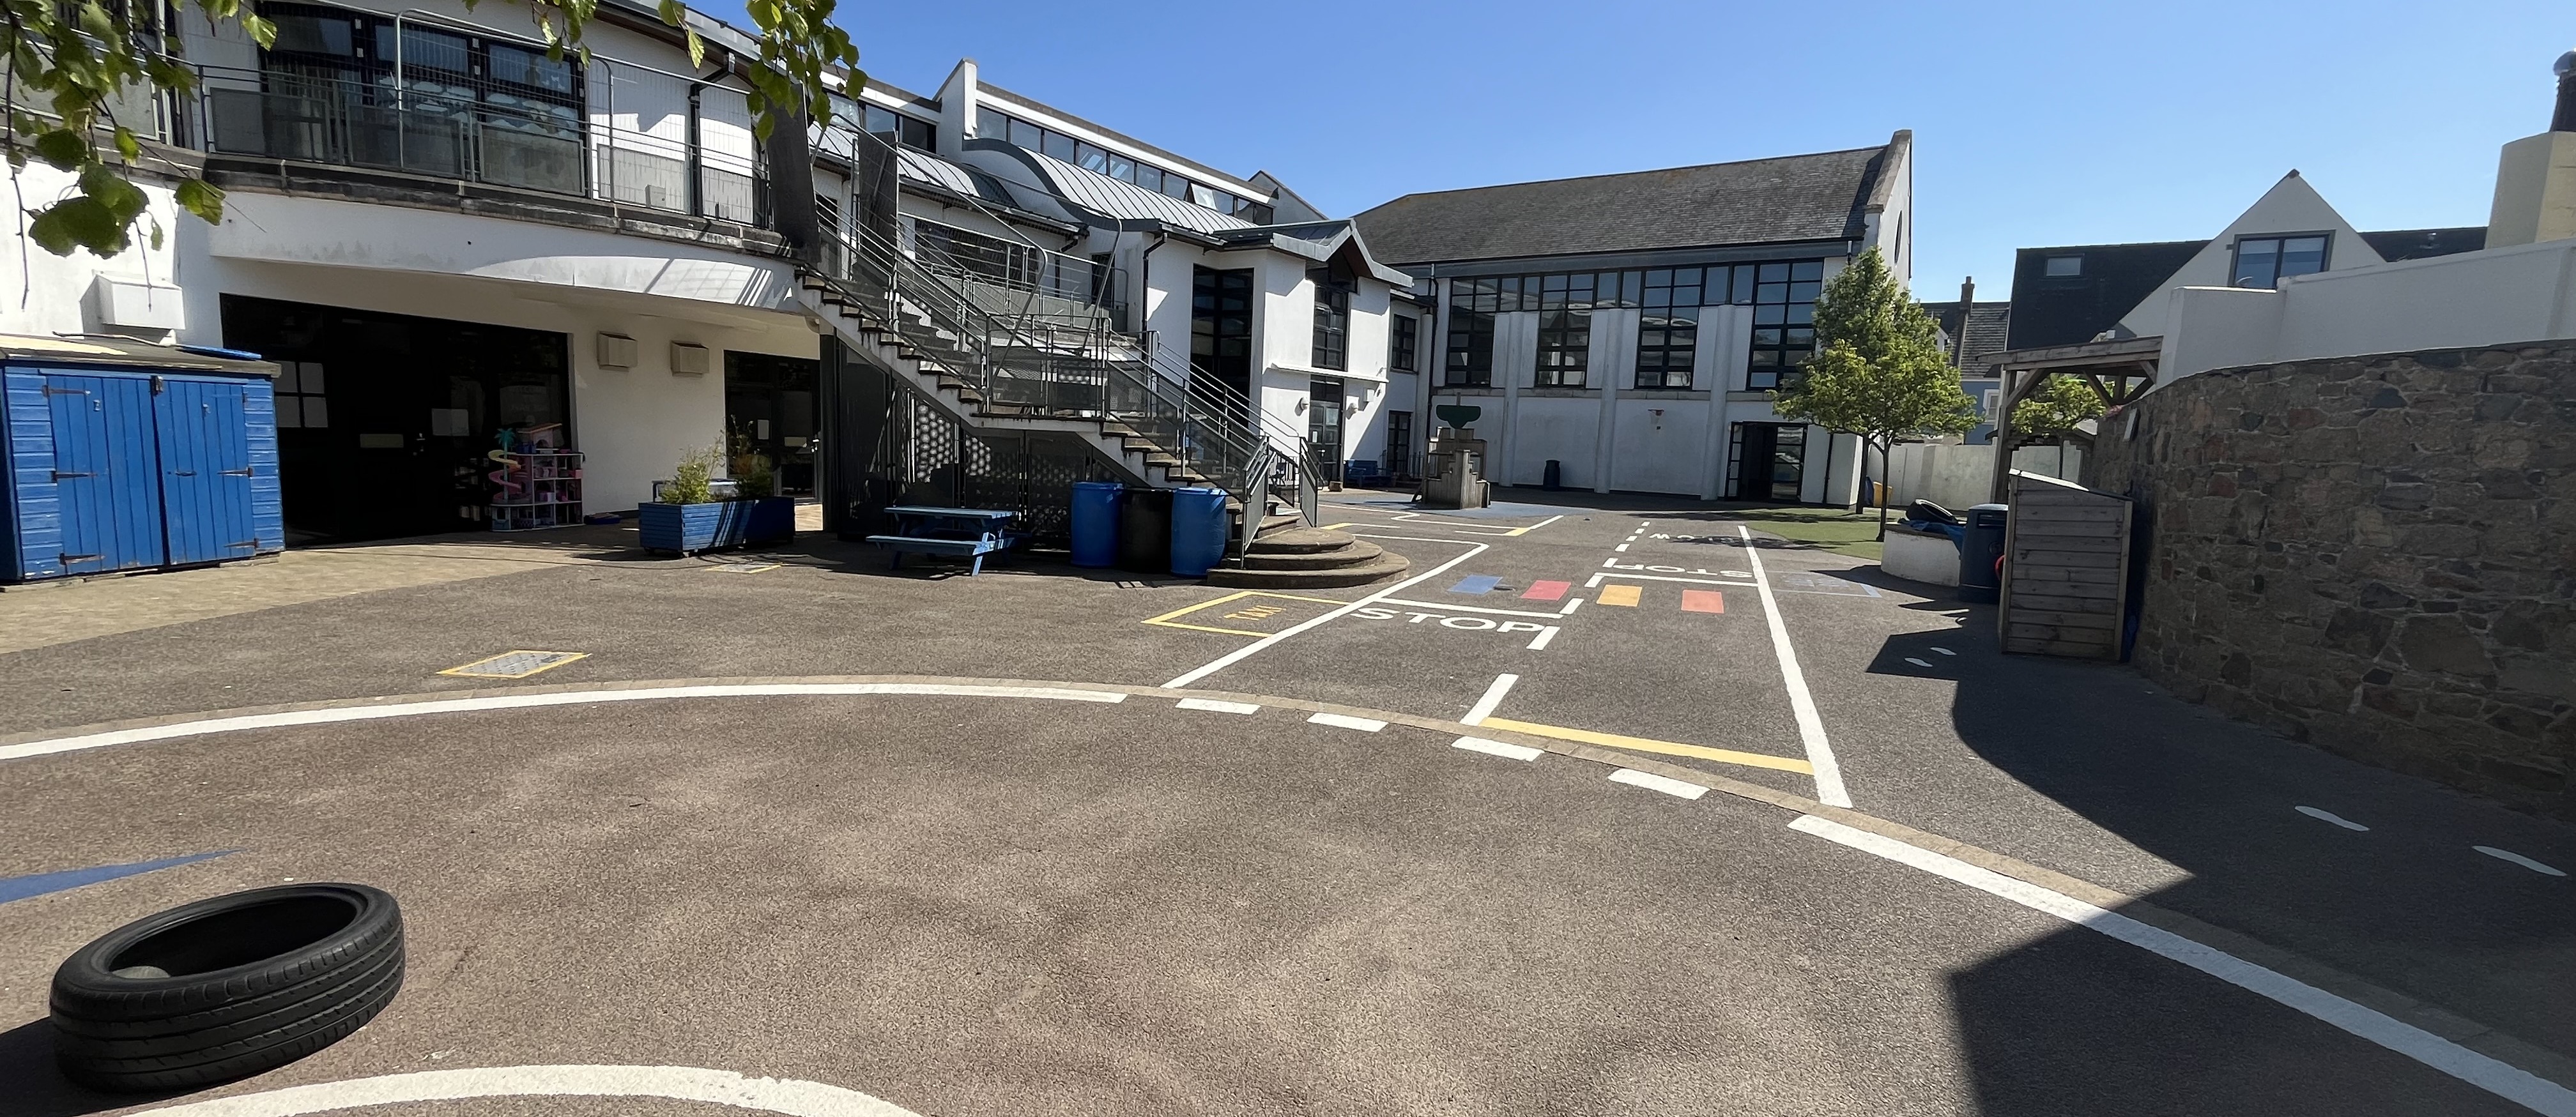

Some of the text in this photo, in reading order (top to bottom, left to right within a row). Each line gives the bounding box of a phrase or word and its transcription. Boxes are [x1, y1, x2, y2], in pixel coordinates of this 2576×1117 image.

[1613, 564, 1753, 577] STOP
[1223, 605, 1287, 621] TAXI
[1350, 607, 1545, 633] STOP
